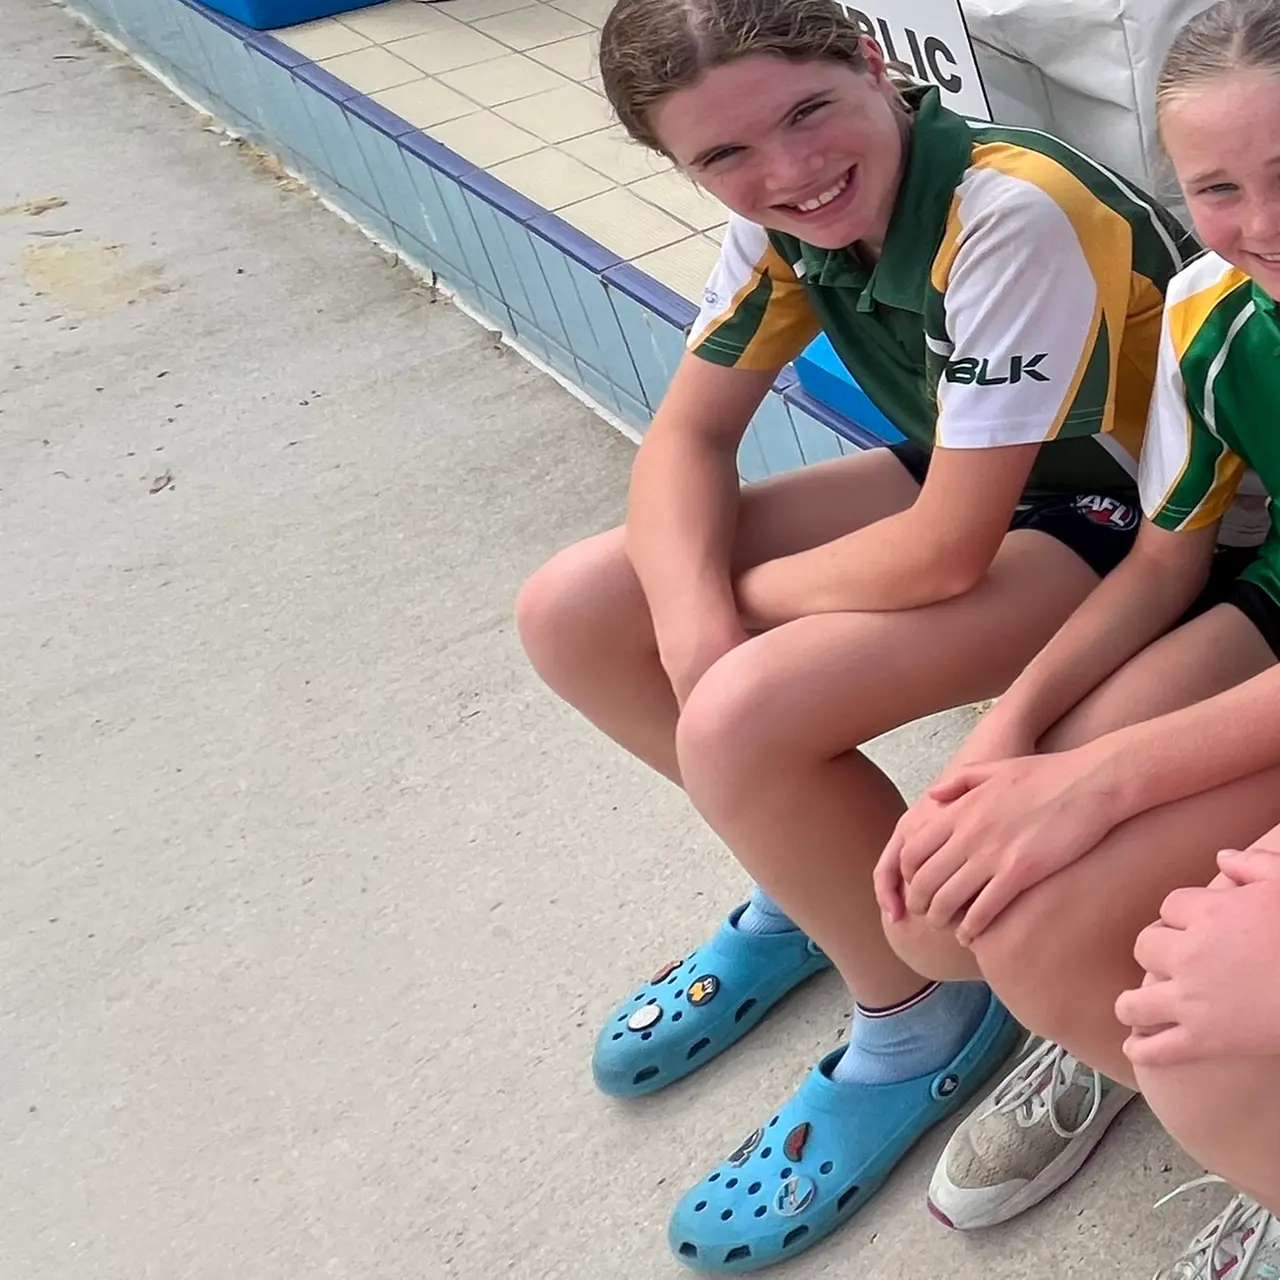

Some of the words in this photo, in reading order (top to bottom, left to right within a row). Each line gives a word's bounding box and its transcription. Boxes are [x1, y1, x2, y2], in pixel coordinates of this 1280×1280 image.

[836, 3, 962, 94] BLIC
[945, 353, 1051, 386] BLK
[1076, 494, 1127, 527] AFL
